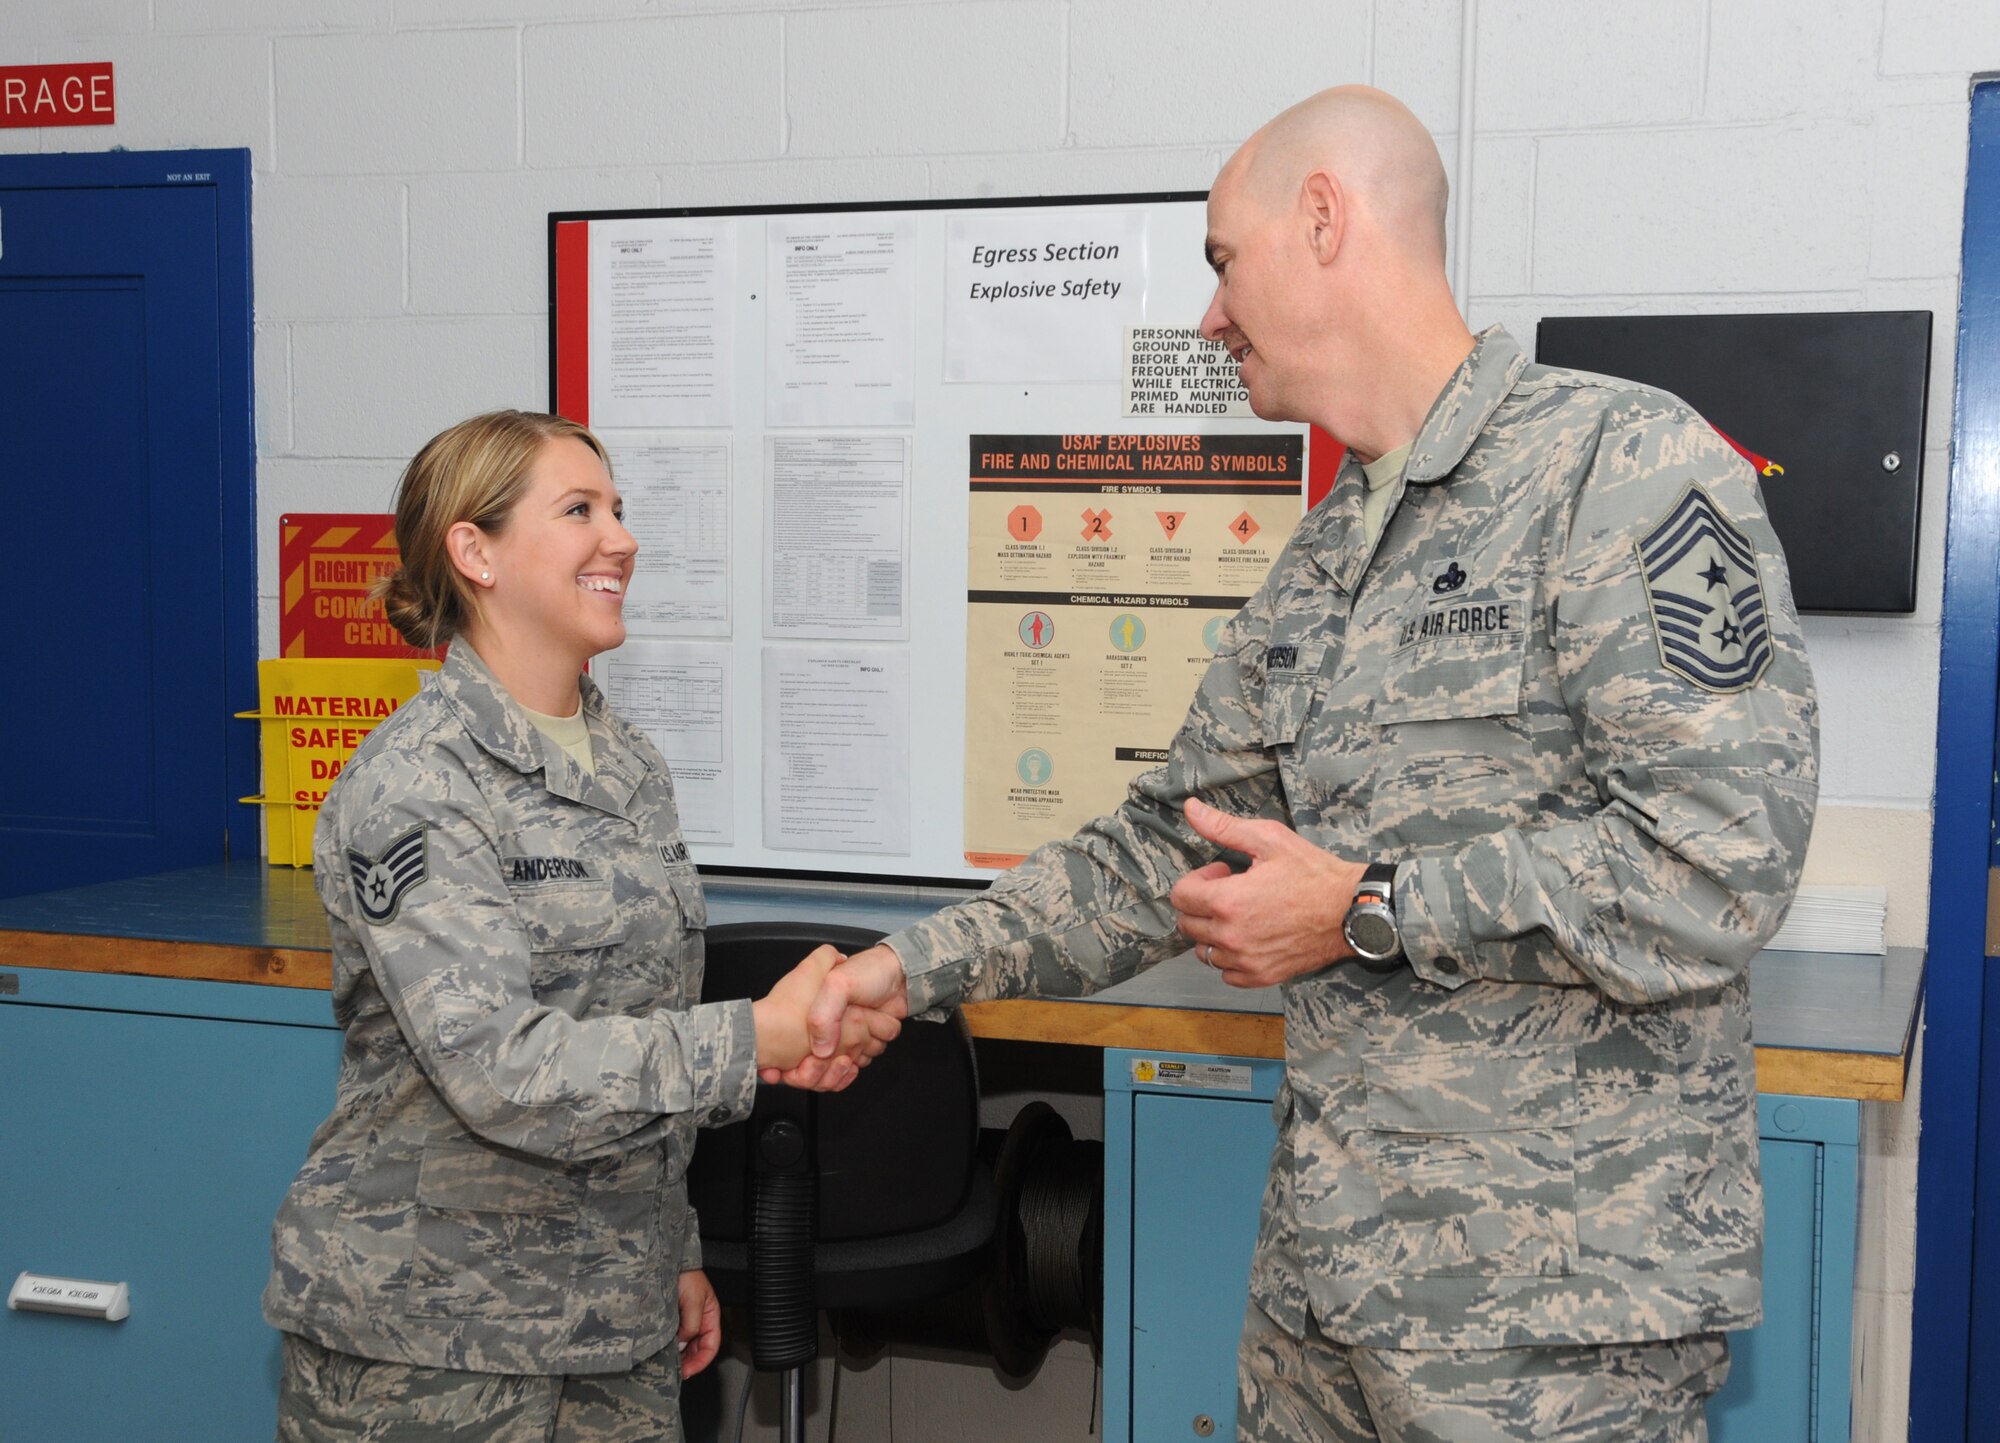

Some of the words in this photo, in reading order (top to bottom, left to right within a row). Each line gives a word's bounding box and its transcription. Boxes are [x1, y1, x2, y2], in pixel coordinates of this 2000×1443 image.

[5, 75, 112, 114] RAGE
[195, 173, 210, 181] EXIT
[972, 246, 1038, 268] Egress
[1043, 242, 1119, 262] Section
[970, 280, 1056, 302] Explosive
[1061, 278, 1121, 300] Safety
[1132, 342, 1190, 352] GROUND
[1132, 354, 1178, 364] BEFORE
[1187, 354, 1216, 364] AND
[1132, 366, 1198, 376] FREQUENT
[1132, 378, 1172, 389] WHILE
[1131, 391, 1178, 401] PRIMED
[1190, 391, 1248, 401] MUNITIO
[1130, 403, 1155, 413] ARE
[1165, 403, 1227, 414] HANDLED
[1062, 435, 1101, 450] USAF
[1108, 435, 1200, 451] EXPLOSIVES
[982, 453, 1014, 469] FIRE
[1020, 454, 1050, 470] AND
[1056, 454, 1134, 470] CHEMICAL
[1142, 455, 1204, 471] HAZARD
[1211, 455, 1287, 472] SYMBOLS
[1122, 486, 1162, 494] SYMBOLS
[1022, 517, 1027, 532] 1
[1092, 517, 1102, 533] 2
[1166, 515, 1176, 531] 3
[1238, 519, 1249, 534] 4
[315, 560, 368, 583] RIGHT
[1070, 596, 1111, 604] CHEMICAL
[1114, 596, 1147, 605] HAZARD
[1150, 597, 1189, 606] SYMBOLS
[1419, 612, 1444, 640] AIR
[1448, 605, 1510, 633] FORCE
[344, 622, 402, 645] CENT
[672, 843, 688, 862] AIR
[513, 858, 590, 881] ANDERSON
[1158, 1070, 1184, 1078] Vidmar
